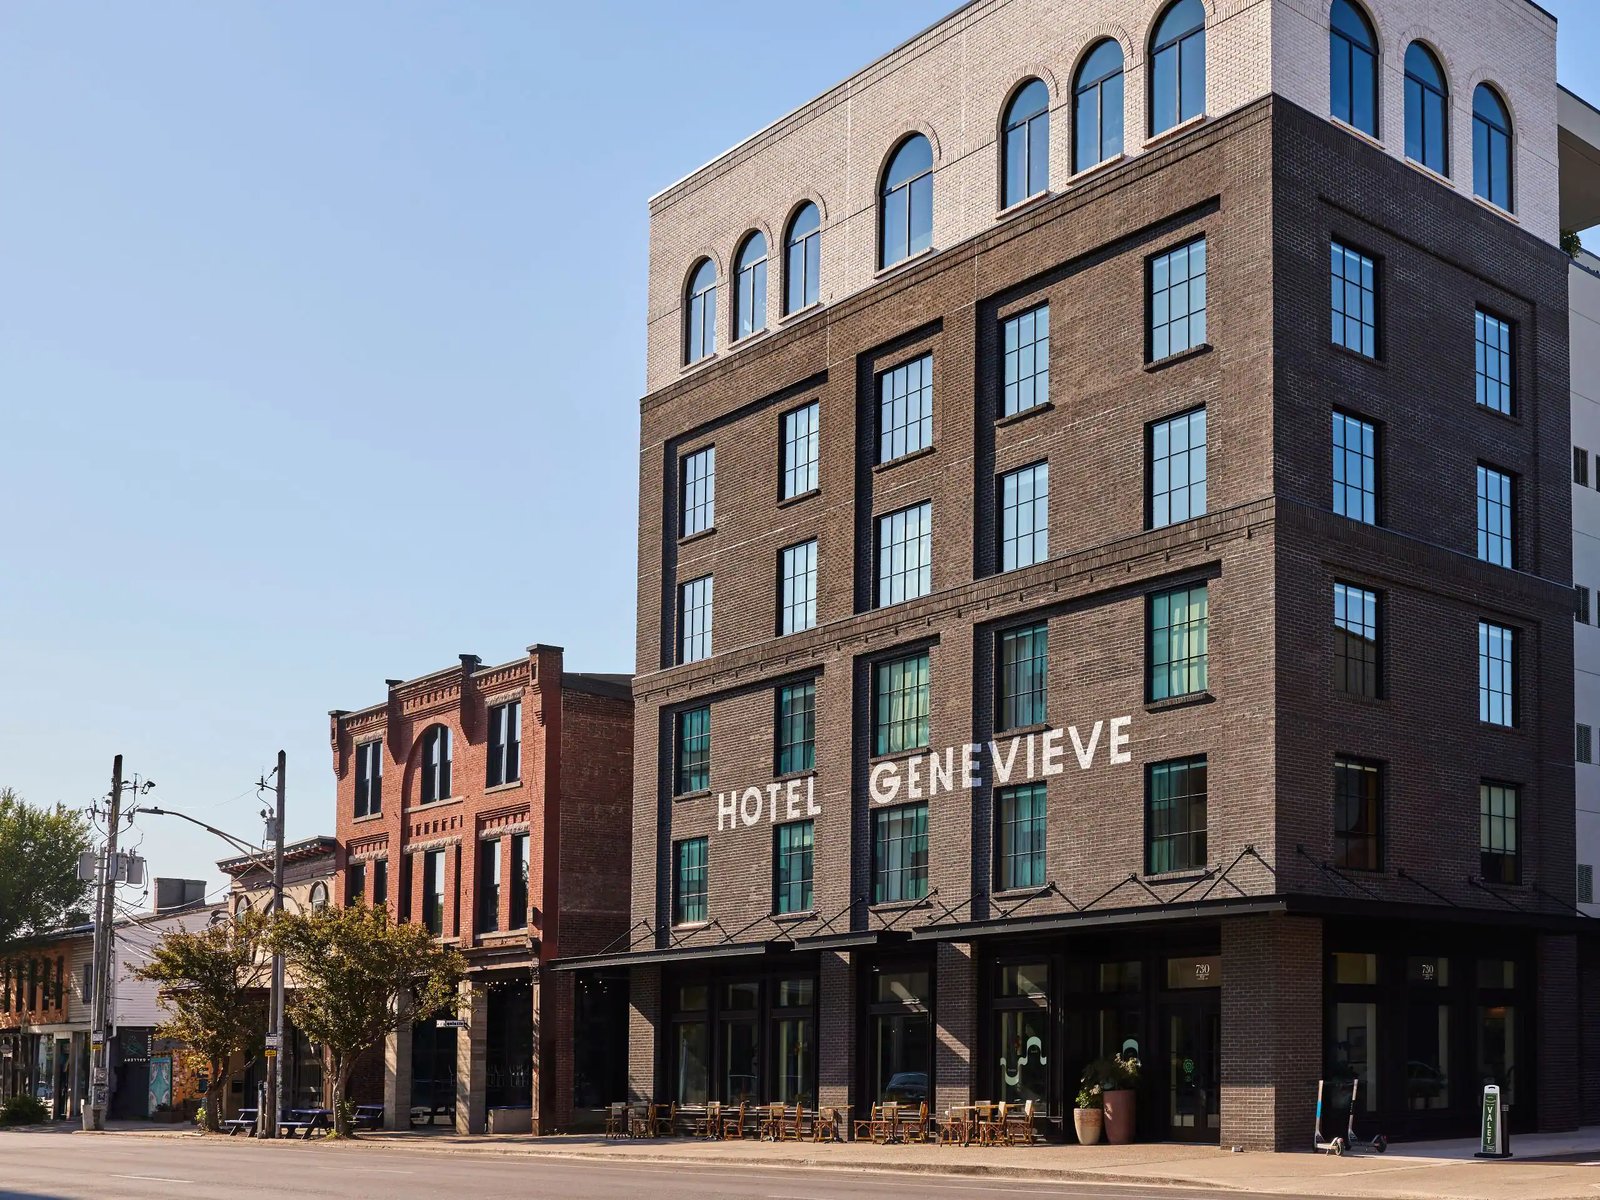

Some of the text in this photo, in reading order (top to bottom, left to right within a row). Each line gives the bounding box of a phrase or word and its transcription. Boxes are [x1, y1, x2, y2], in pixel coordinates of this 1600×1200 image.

[717, 716, 1132, 831] HOTEL GENEVIEVE
[1195, 964, 1210, 974] 730
